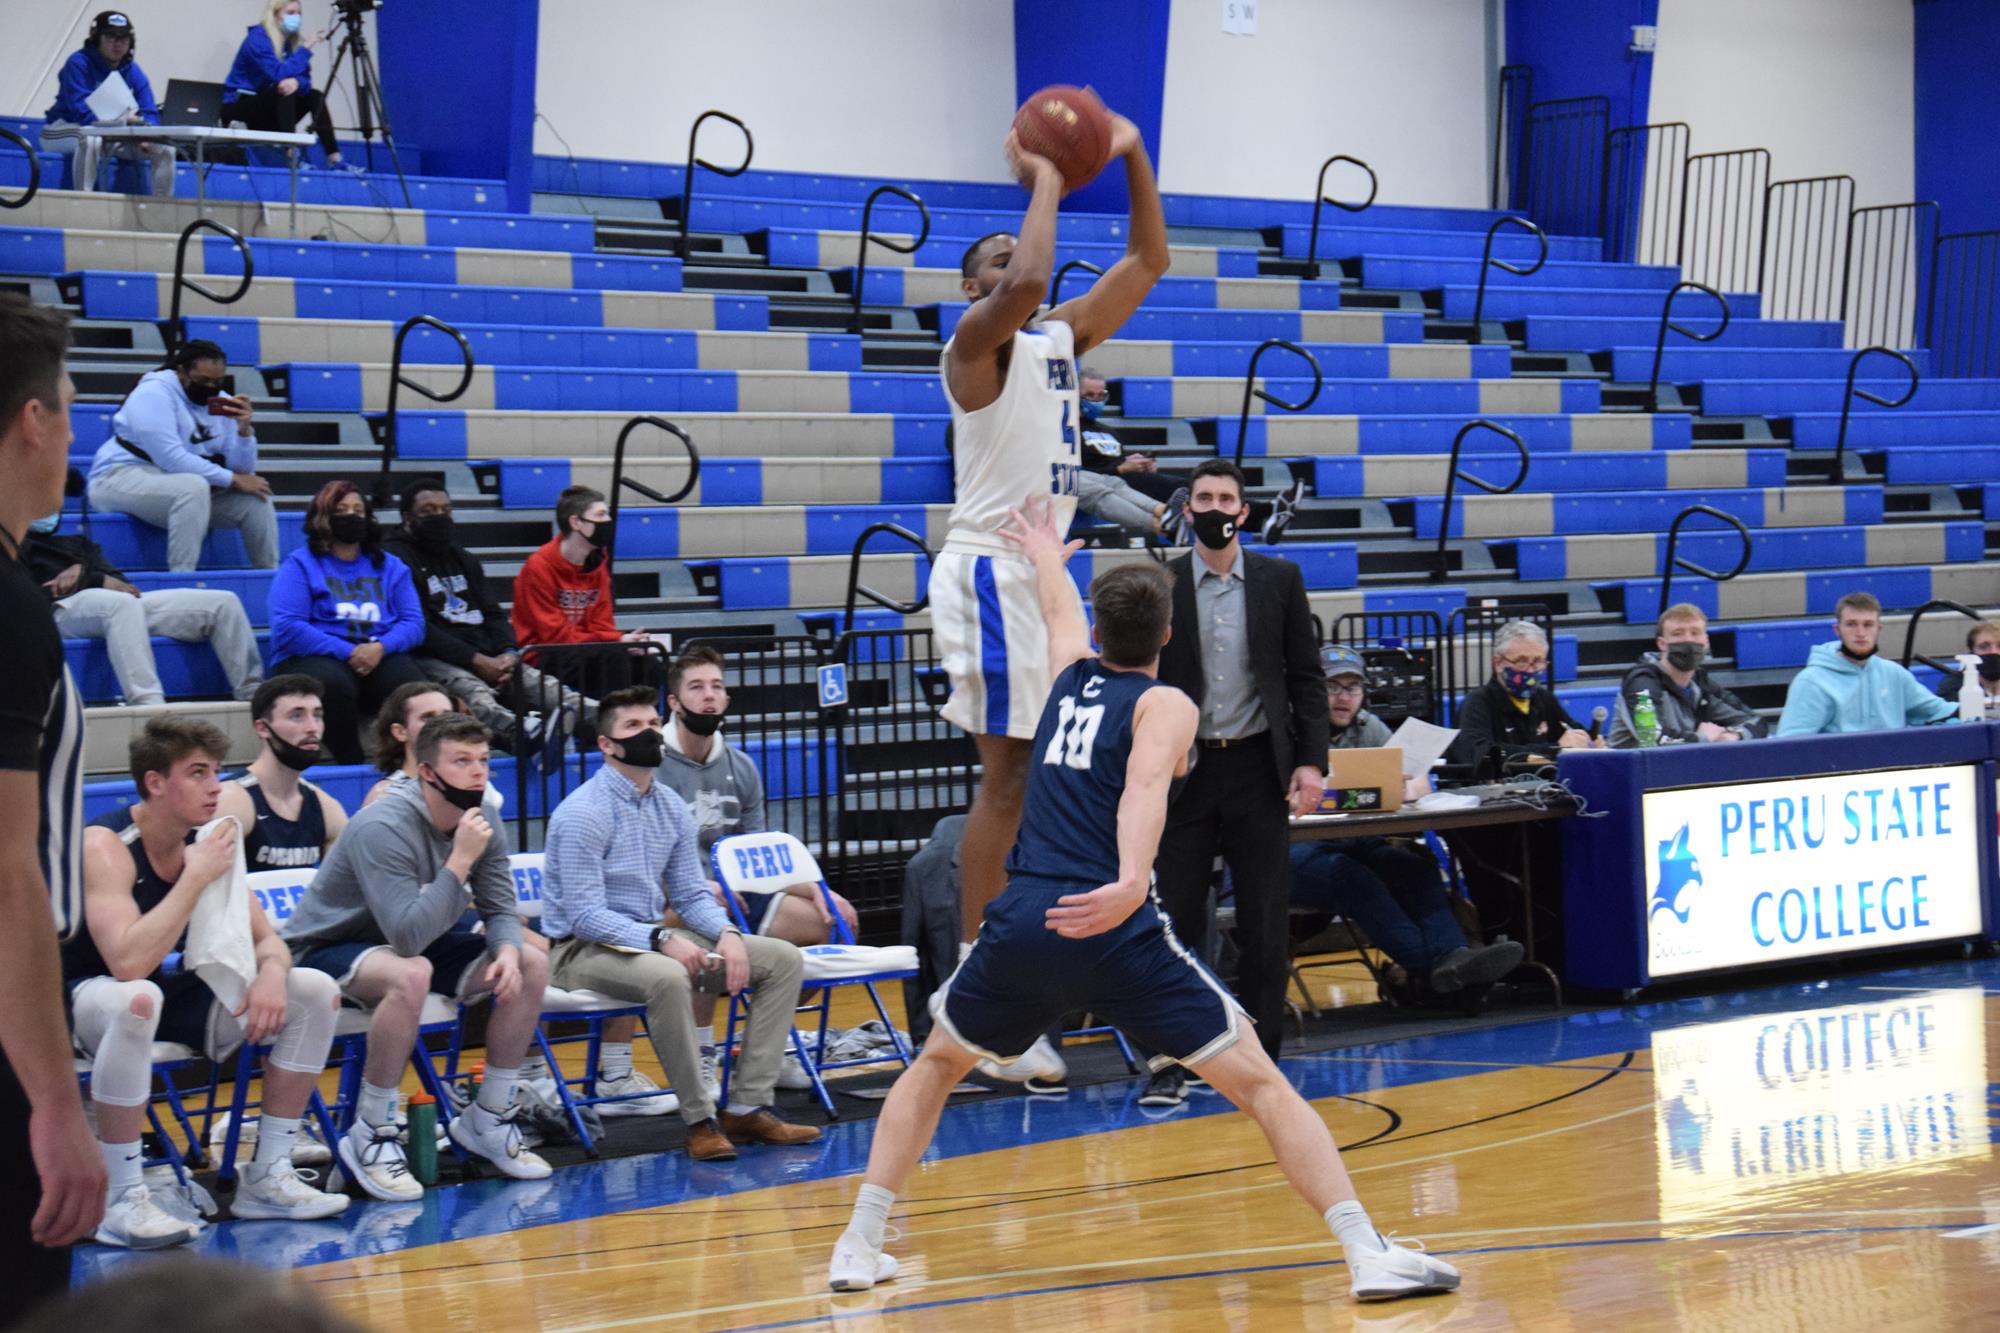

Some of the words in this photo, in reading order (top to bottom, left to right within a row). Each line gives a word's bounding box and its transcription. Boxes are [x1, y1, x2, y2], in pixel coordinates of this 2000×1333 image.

[1228, 3, 1236, 19] S
[1241, 4, 1255, 20] W
[1222, 522, 1234, 538] C
[1082, 675, 1106, 698] C
[1043, 695, 1105, 770] 10
[1720, 794, 1826, 858] PERU
[1843, 782, 1952, 845] STATE
[734, 843, 794, 879] PERU
[512, 867, 542, 901] ER
[1751, 874, 1931, 947] COLLEGE
